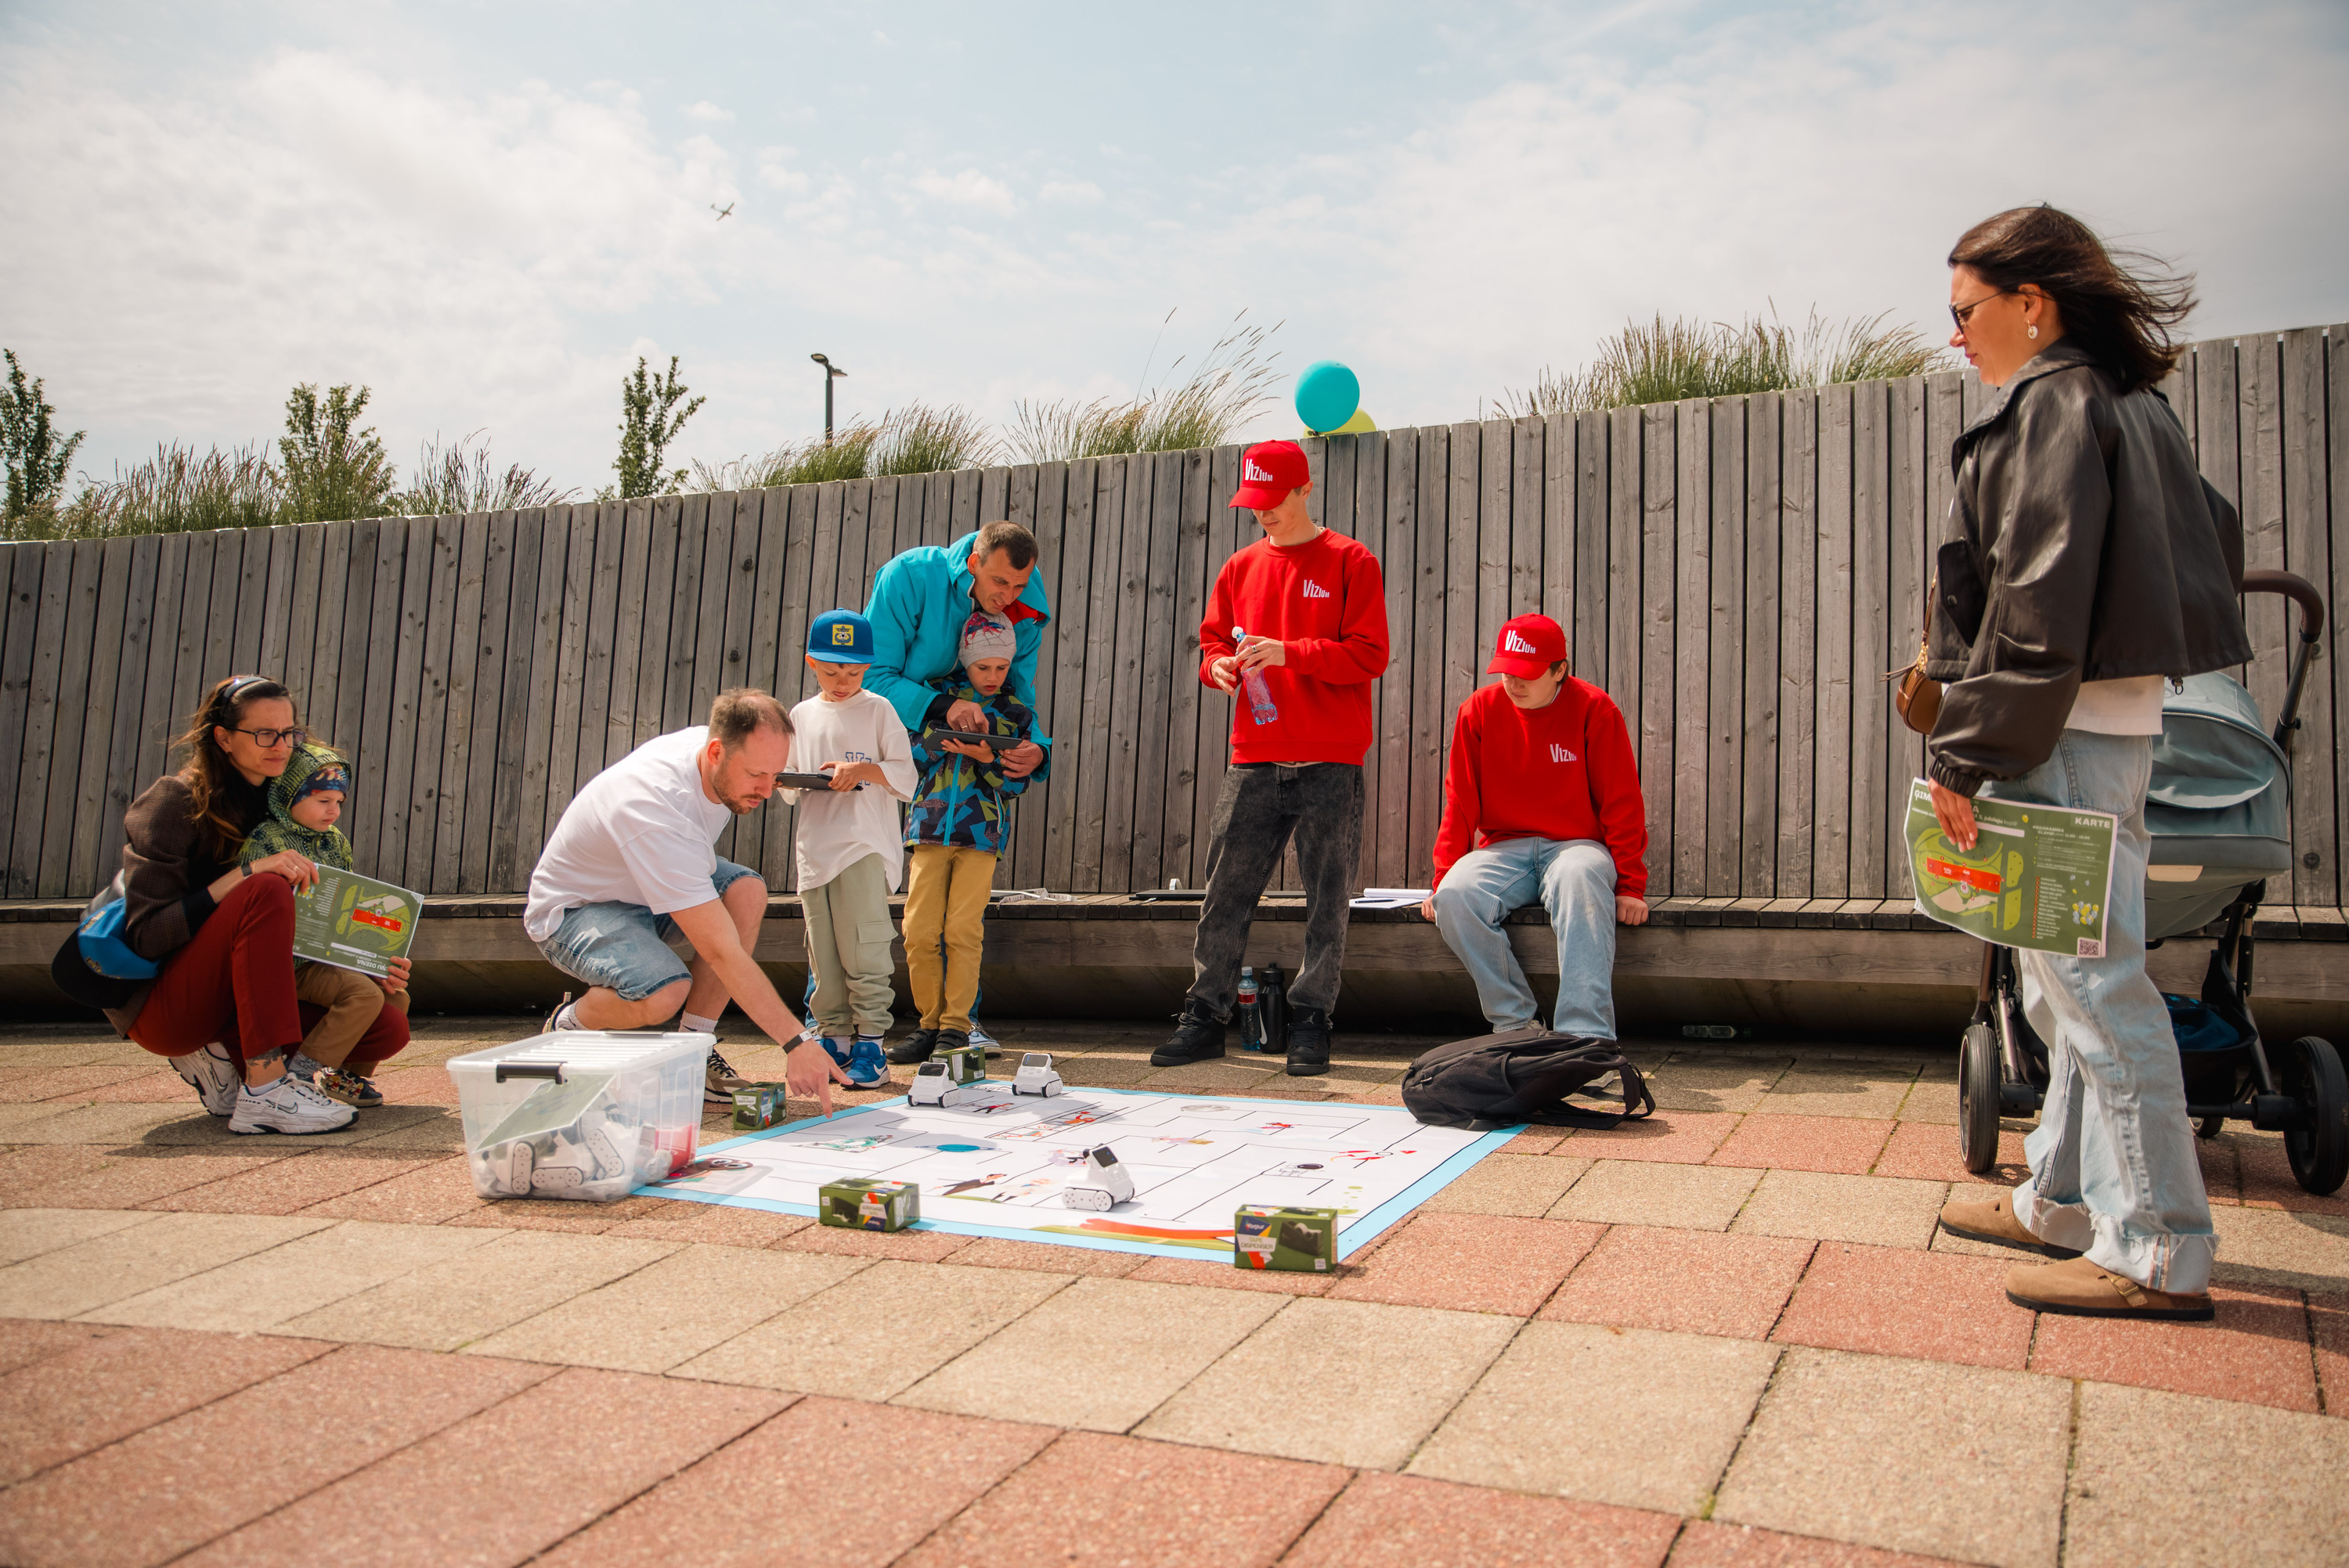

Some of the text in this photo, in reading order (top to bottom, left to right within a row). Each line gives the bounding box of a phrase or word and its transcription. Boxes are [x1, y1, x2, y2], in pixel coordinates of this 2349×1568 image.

[1914, 789, 1932, 802] ĢIM
[2075, 816, 2110, 828] KARTE
[357, 959, 377, 968] DIENA
